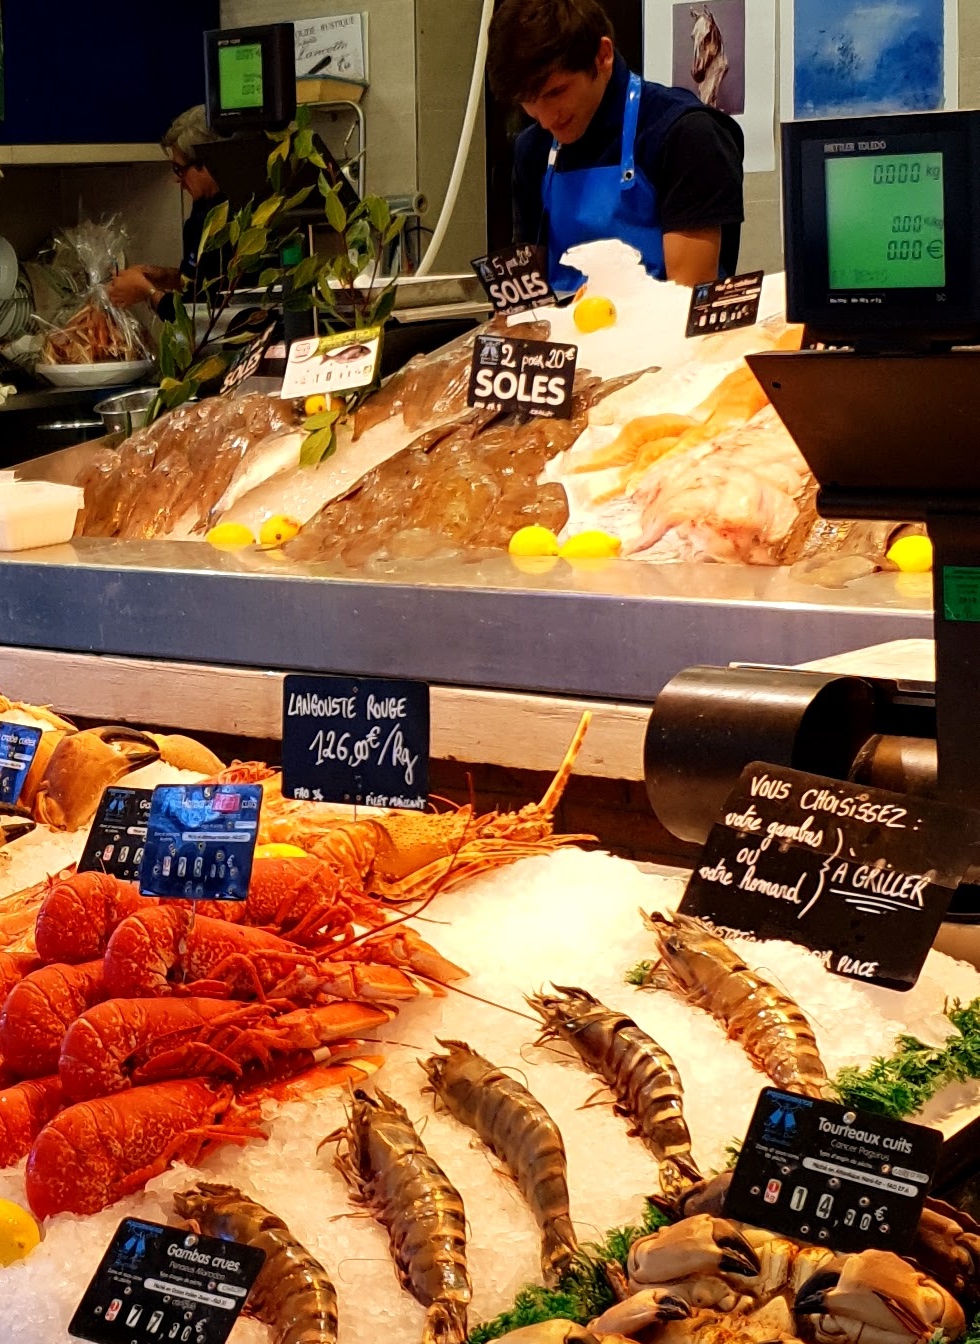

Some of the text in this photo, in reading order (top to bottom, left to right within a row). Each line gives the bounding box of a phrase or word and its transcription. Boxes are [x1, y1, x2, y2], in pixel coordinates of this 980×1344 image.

[858, 140, 886, 151] TOLEDO
[925, 164, 940, 181] kg
[926, 239, 943, 260] €
[489, 271, 549, 308] SOLES
[500, 343, 517, 369] 2
[474, 368, 566, 406] SOLES
[287, 692, 408, 721] LANGOUSTE ROUGE
[294, 786, 310, 799] FAO
[750, 774, 792, 800] VOUS
[725, 805, 824, 852] votre gambas
[699, 858, 807, 905] votre homard
[836, 955, 880, 978] PLACE
[818, 1116, 914, 1155] Tourteaux cuits
[830, 1138, 858, 1154] Cancer
[873, 1205, 888, 1222] €
[167, 1243, 241, 1273] Gambas crues
